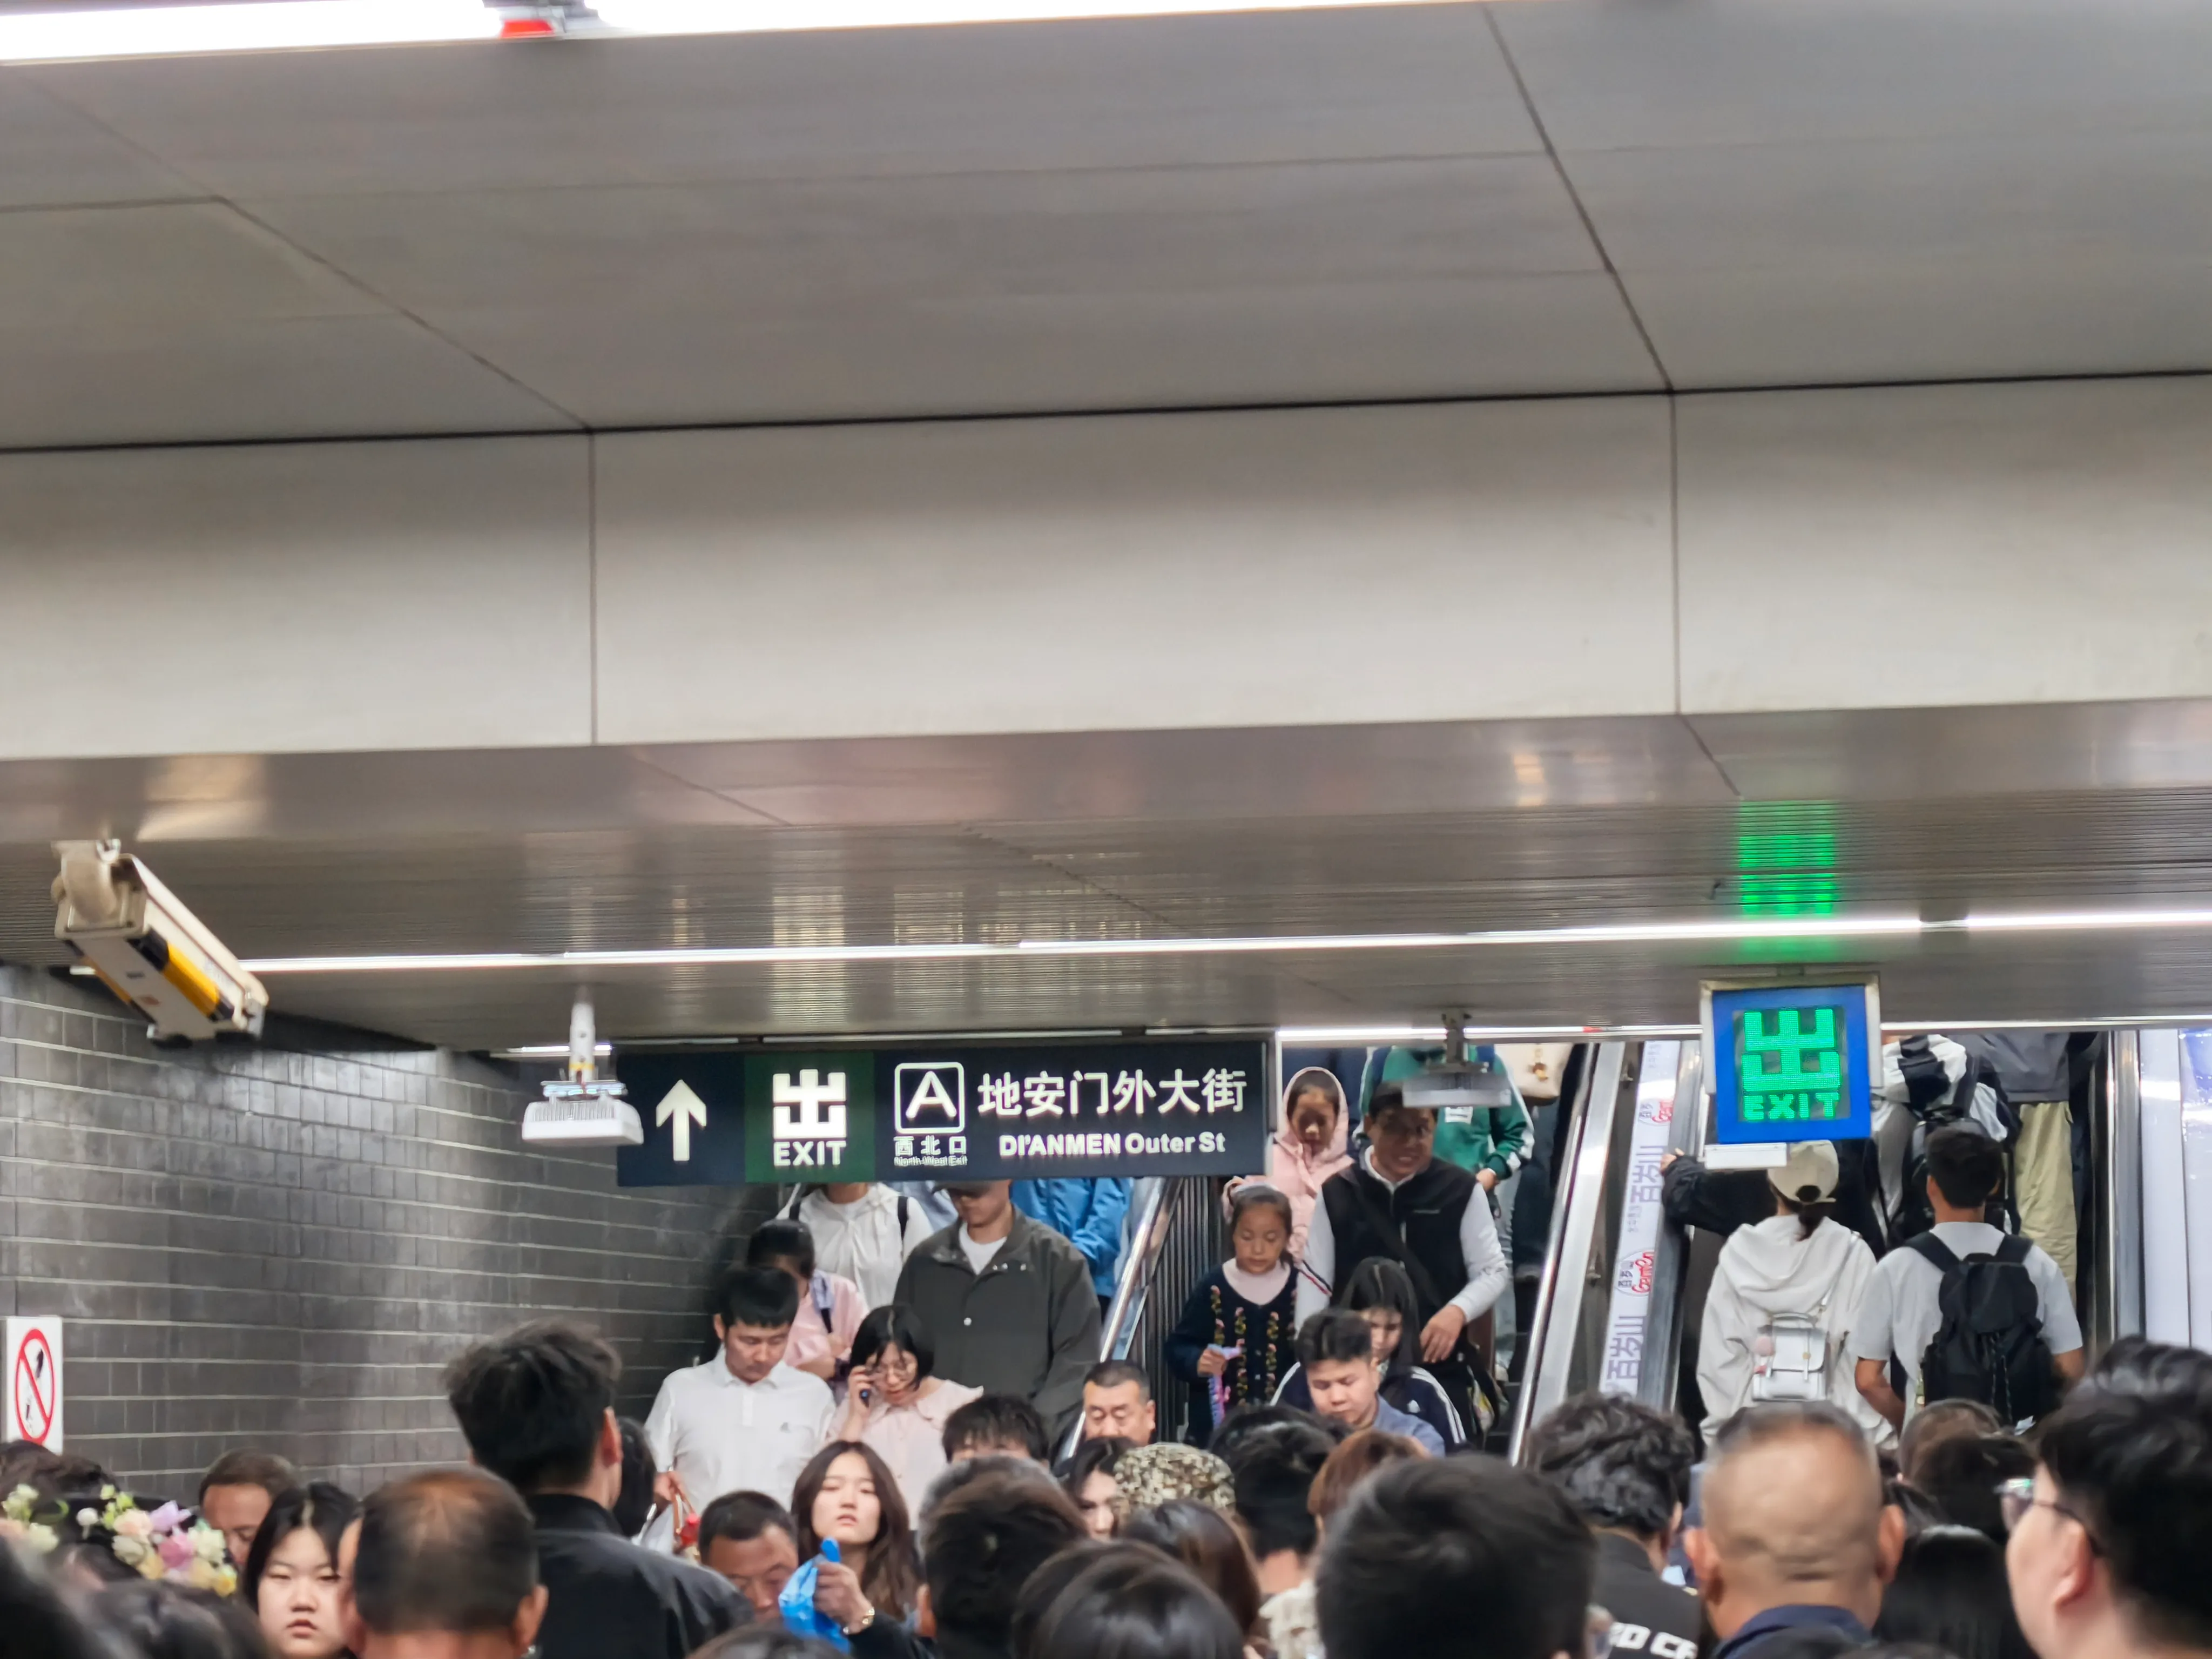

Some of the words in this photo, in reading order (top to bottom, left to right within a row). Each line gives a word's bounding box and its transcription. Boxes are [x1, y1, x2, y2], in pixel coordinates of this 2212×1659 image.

[1742, 1009, 1840, 1091] 出
[773, 1069, 846, 1139] 出
[906, 1070, 957, 1119] A
[978, 1068, 1247, 1116] 地安门外大街
[1743, 1092, 1839, 1120] EXIT
[773, 1141, 846, 1166] EXIT
[893, 1135, 966, 1156] 西北口
[948, 1155, 968, 1166] Exit
[999, 1133, 1121, 1156] DI'ANMEN
[1125, 1132, 1195, 1154] Outer
[1198, 1131, 1226, 1152] St
[1630, 1145, 1667, 1203] 百岁山
[1607, 1316, 1647, 1379] 百岁山
